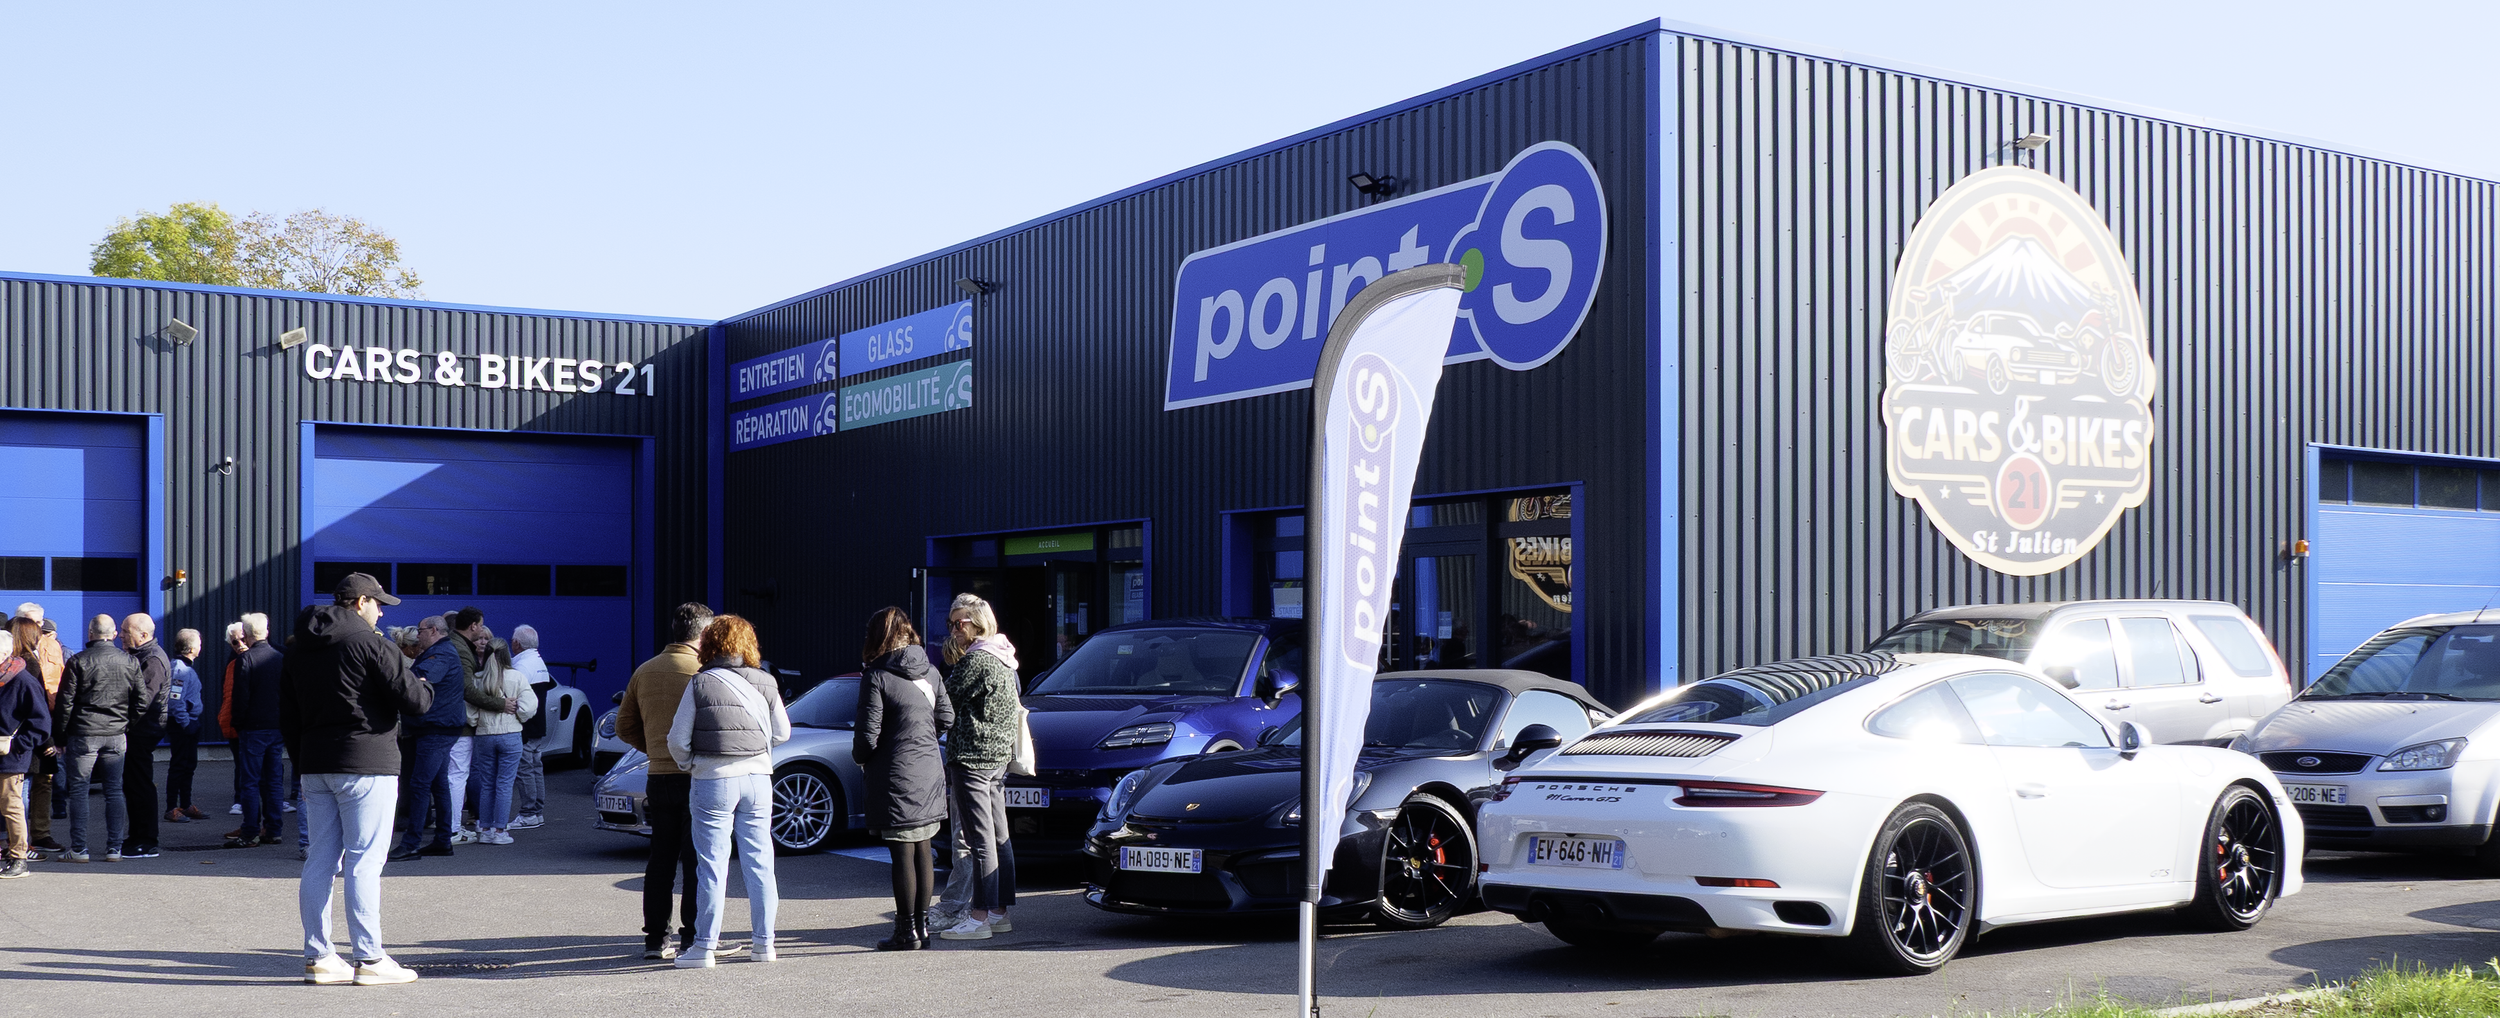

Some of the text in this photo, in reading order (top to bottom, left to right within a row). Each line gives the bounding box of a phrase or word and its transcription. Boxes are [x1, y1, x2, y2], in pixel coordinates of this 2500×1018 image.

[1492, 184, 1575, 325] S
[868, 325, 914, 363] GLASS
[305, 343, 655, 397] CARS & BIKES 21
[739, 352, 805, 394] ENTRETIEN
[845, 370, 941, 423] ÉCOMOBILITÉ
[736, 404, 809, 445] RÉPARATION
[1899, 394, 2145, 470] CARS & BIKES
[1350, 368, 1390, 645] point S
[2007, 470, 2041, 511] 21
[1038, 540, 1060, 549] ACCUEIL
[1971, 530, 2078, 555] St Julien
[1535, 784, 1637, 793] PORSCHE
[1128, 850, 1191, 869] HA-089-NE
[1192, 861, 1200, 871] 21
[1536, 839, 1613, 864] EV-646-NH
[1613, 855, 1622, 868] 21
[2149, 868, 2171, 878] GTS
